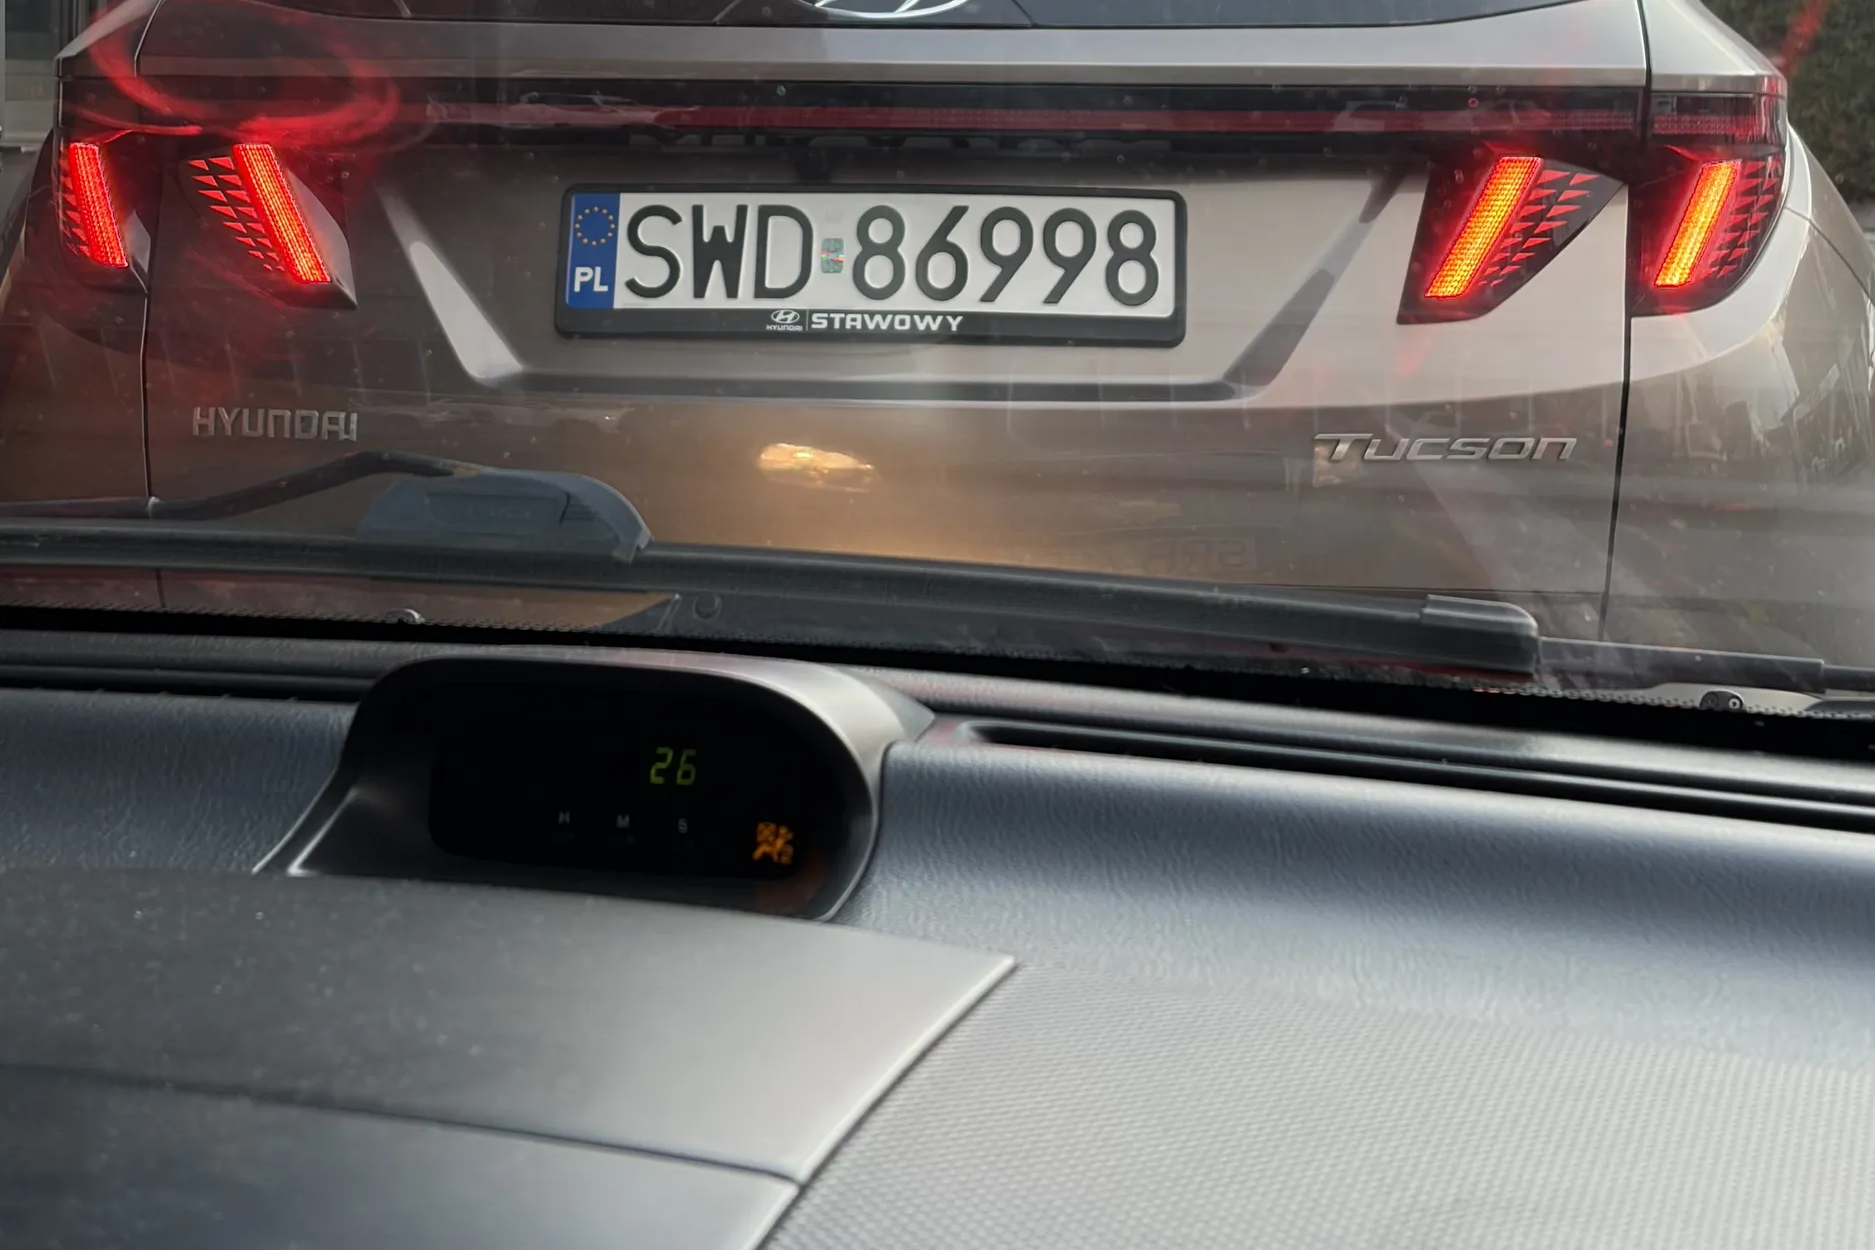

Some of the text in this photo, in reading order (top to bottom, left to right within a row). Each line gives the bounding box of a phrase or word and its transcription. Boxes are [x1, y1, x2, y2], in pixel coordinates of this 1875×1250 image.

[624, 203, 1161, 307] SWD 86998
[573, 266, 609, 293] PL
[766, 324, 803, 332] HYUNDAI
[811, 312, 964, 332] STAWOWY
[192, 406, 358, 443] HYUNDAI
[649, 747, 697, 786] 26
